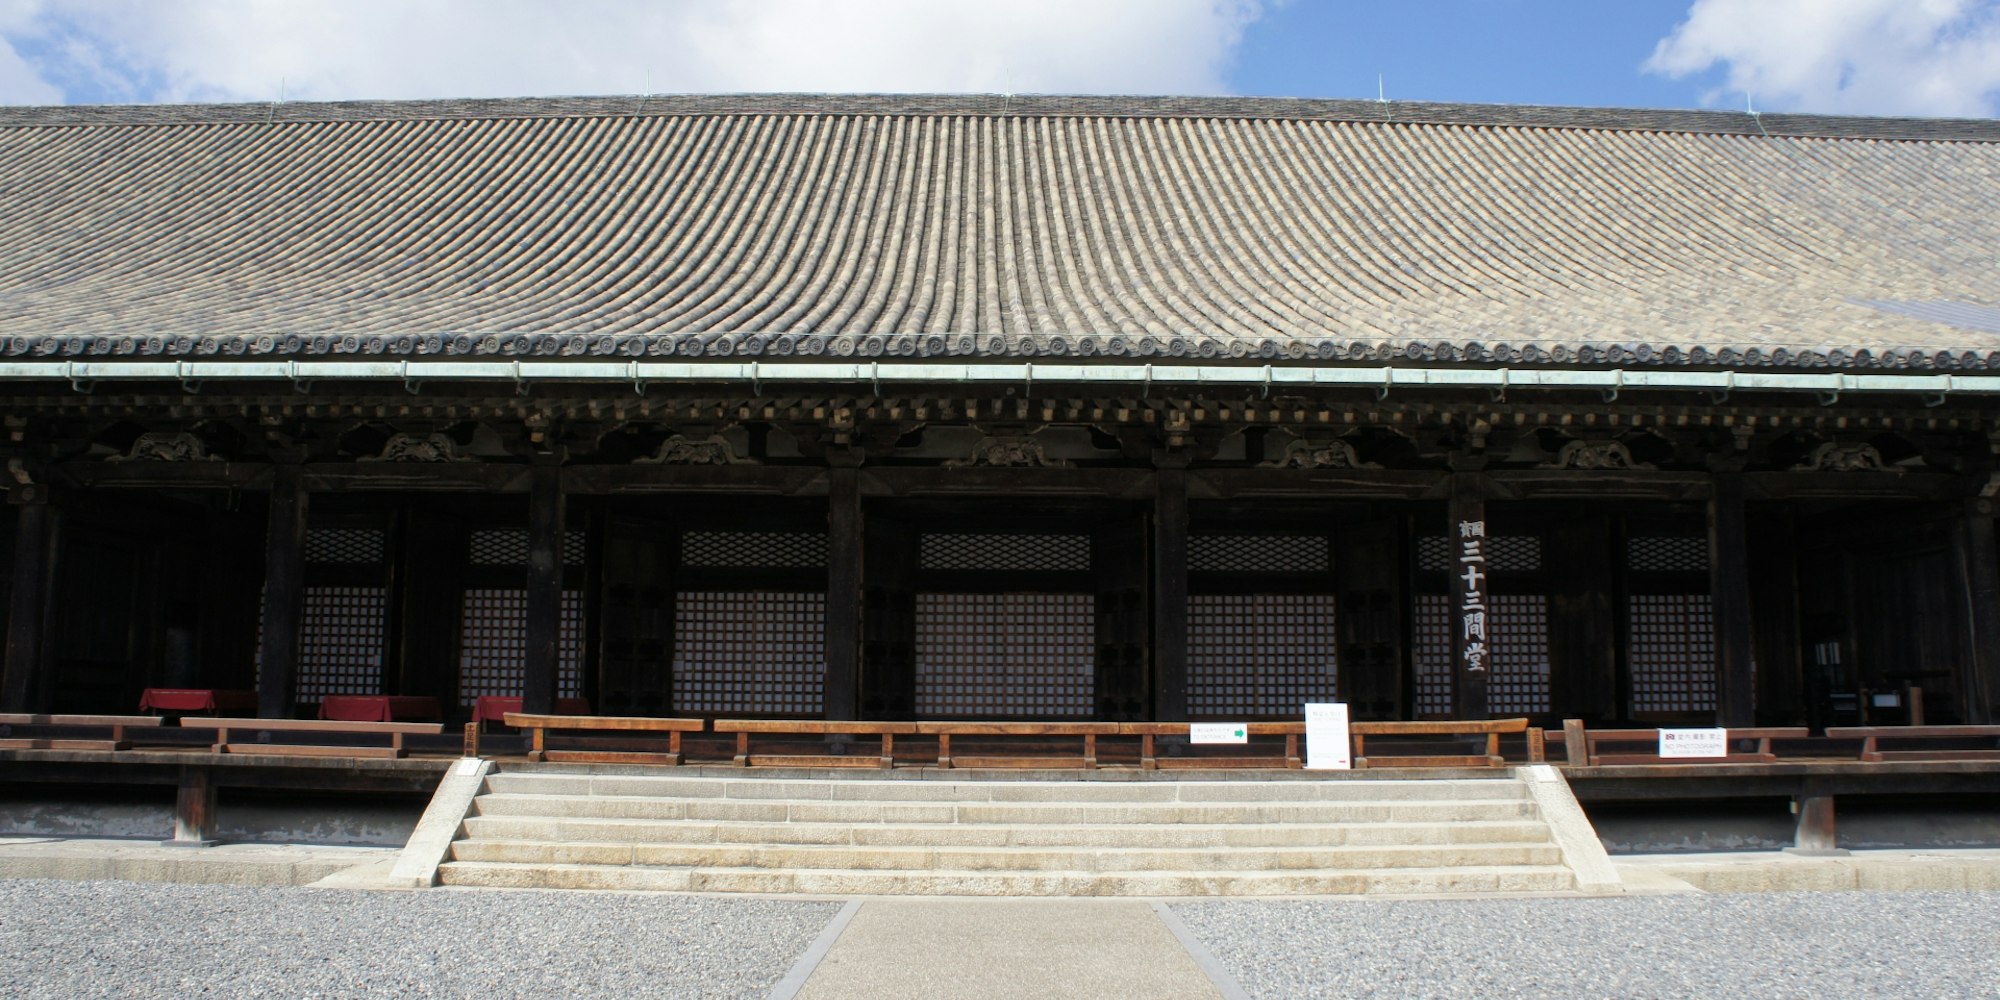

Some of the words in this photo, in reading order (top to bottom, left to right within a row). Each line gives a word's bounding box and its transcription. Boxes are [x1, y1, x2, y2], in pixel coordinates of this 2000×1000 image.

[1460, 540, 1488, 671] 三十三間堂
